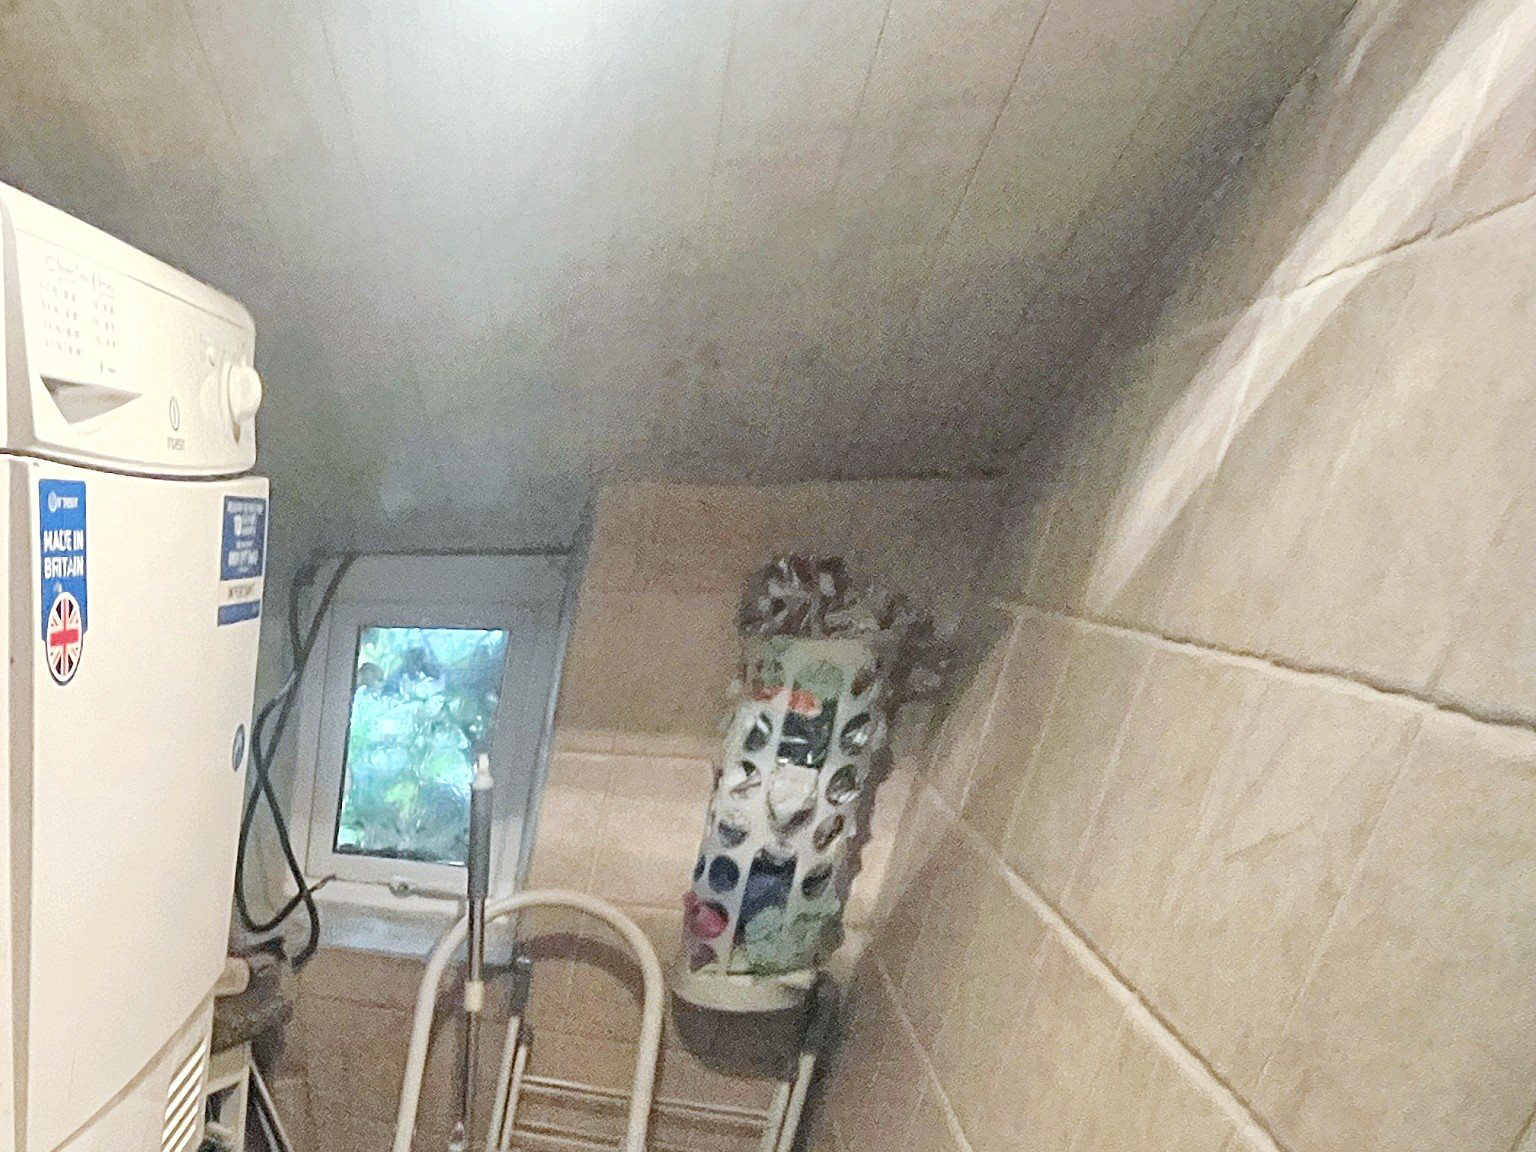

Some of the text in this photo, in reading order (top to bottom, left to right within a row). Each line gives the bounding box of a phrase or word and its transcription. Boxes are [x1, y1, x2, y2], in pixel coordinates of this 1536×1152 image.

[44, 530, 84, 551] MADE IN
[44, 555, 84, 578] BRITAIN
